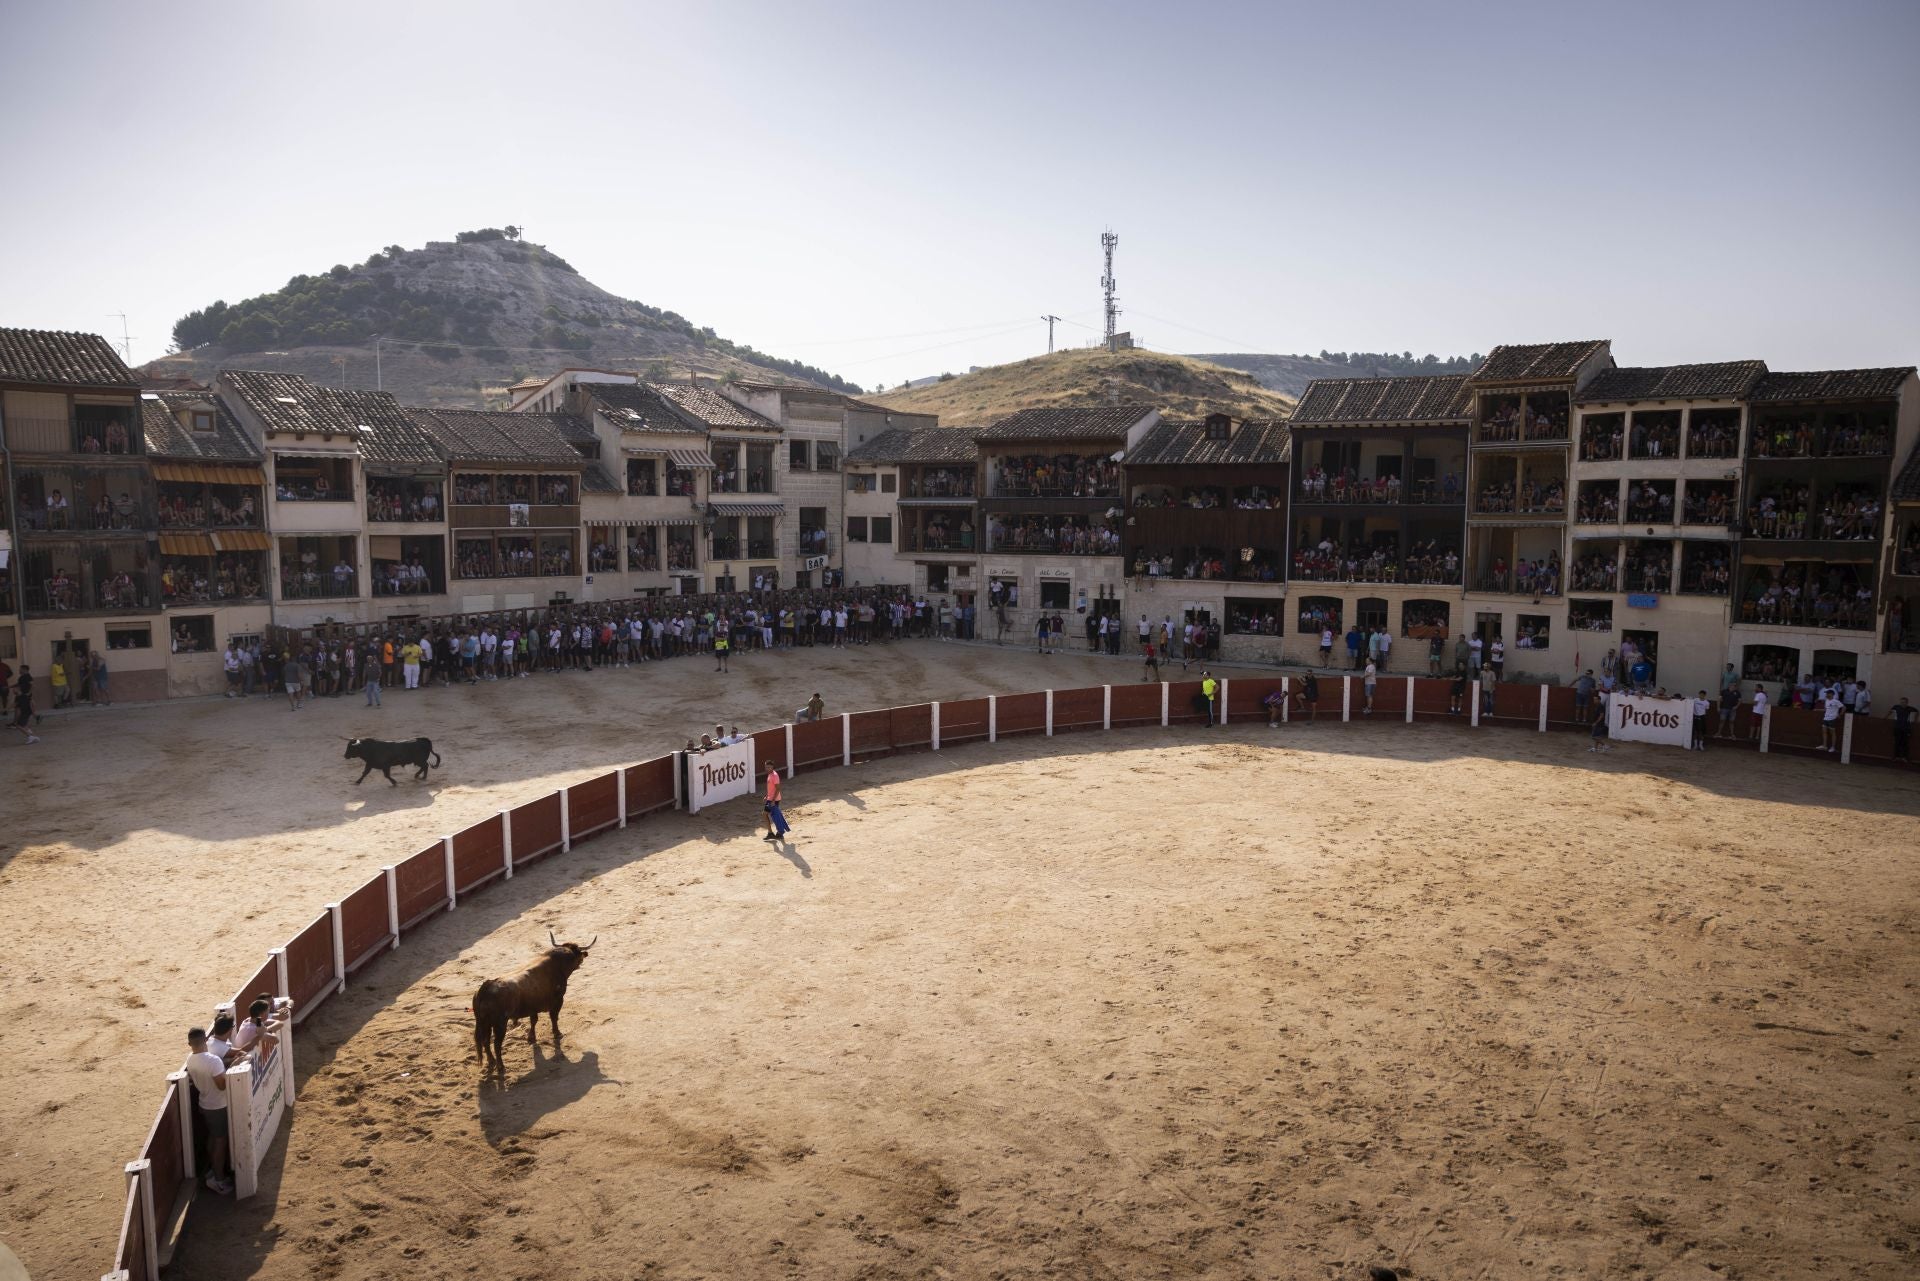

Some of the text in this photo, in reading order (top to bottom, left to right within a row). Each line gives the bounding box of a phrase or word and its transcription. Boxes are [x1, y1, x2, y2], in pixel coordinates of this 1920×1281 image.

[808, 557, 824, 569] BAR
[1617, 703, 1680, 729] Protos
[698, 761, 746, 797] Protos
